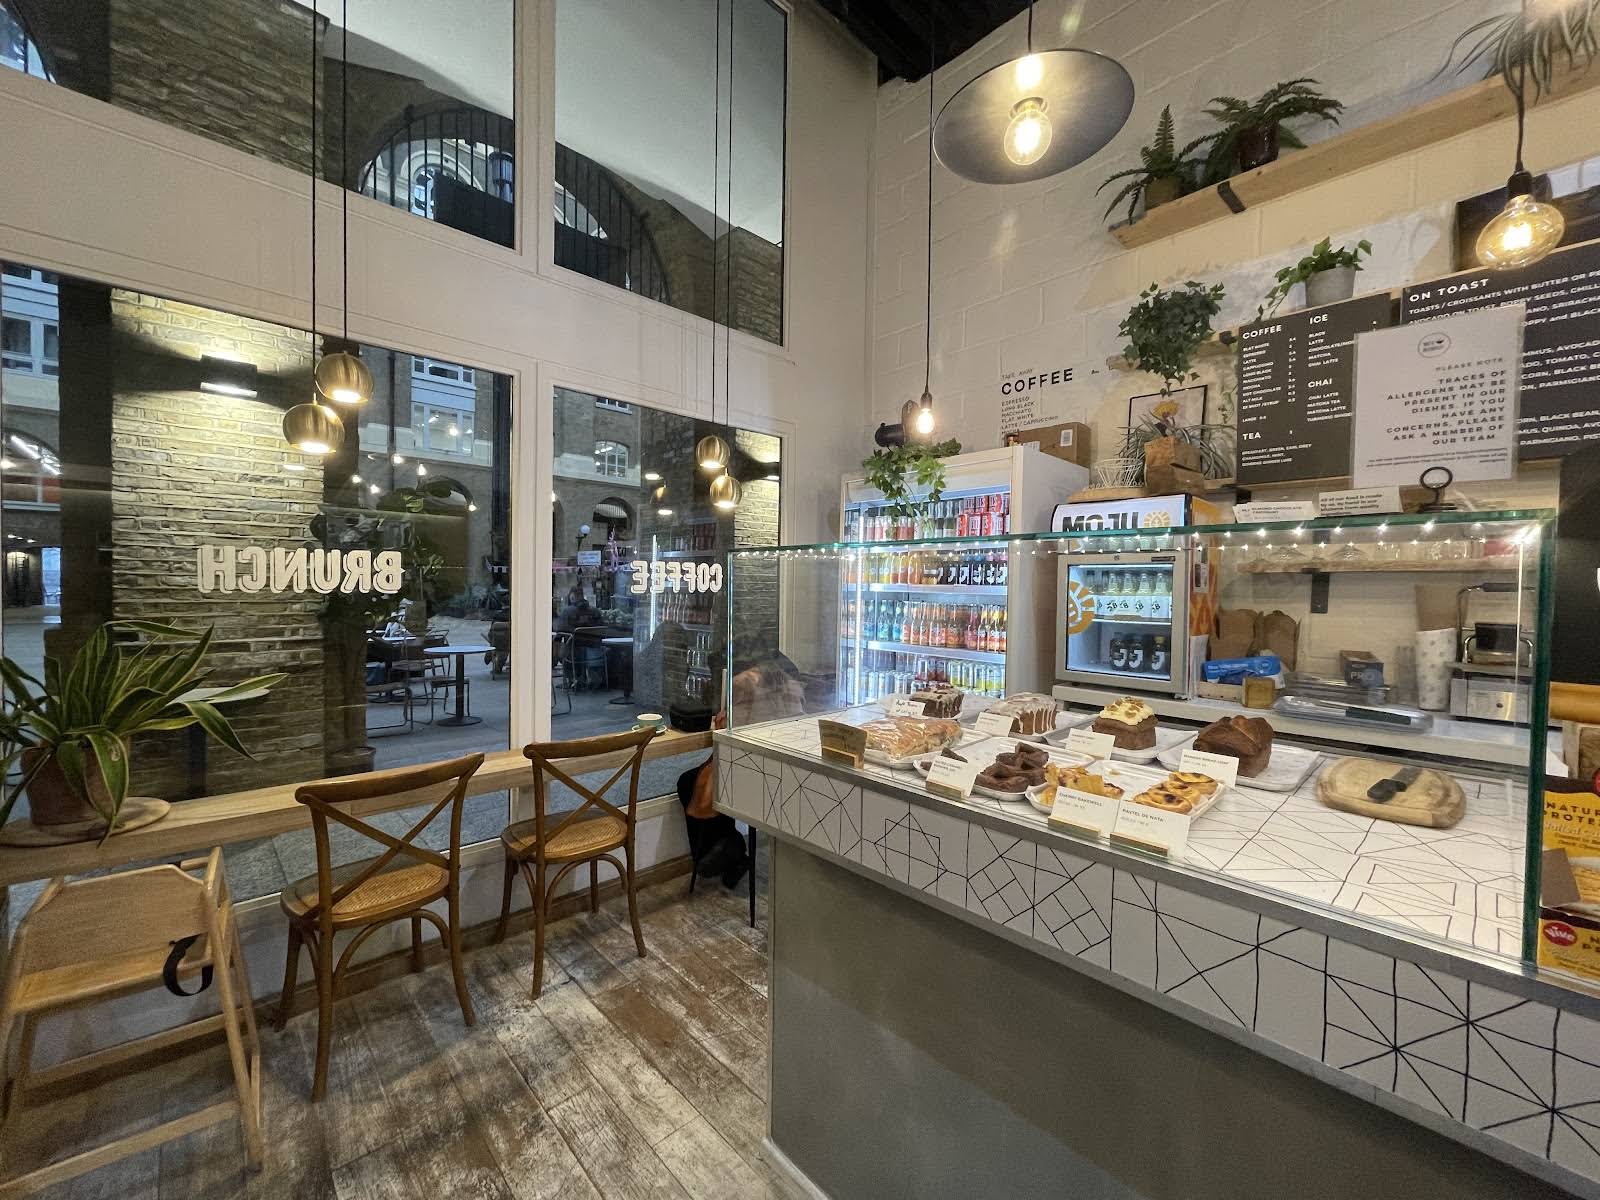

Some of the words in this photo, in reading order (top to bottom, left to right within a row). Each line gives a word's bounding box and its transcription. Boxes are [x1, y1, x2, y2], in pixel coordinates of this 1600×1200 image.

[1409, 291, 1431, 302] ON
[1437, 278, 1489, 296] TOAST
[1409, 303, 1440, 315] TOASTS
[1447, 290, 1502, 307] CROISSANTS
[1503, 285, 1529, 295] WITH
[1531, 277, 1569, 290] BUTTER
[1570, 273, 1586, 281] OR
[1309, 314, 1328, 325] ICE
[1242, 325, 1282, 340] COFFEE
[1308, 338, 1324, 346] LATTE
[1556, 339, 1600, 352] AVOCAD
[1436, 361, 1472, 372] PLEASE
[1553, 365, 1587, 375] BLACK
[1001, 368, 1073, 395] COFFEE
[1308, 378, 1332, 388] CHAI
[1439, 373, 1485, 385] TRACES
[1490, 369, 1507, 377] OF
[1387, 386, 1454, 401] ALLERGENS
[1459, 382, 1485, 391] MAY
[1404, 393, 1457, 407] PRESENT
[1480, 388, 1506, 397] OUR
[1001, 396, 1030, 407] ESPRESSO
[1017, 401, 1035, 409] BLACK
[1480, 397, 1505, 406] YOU
[1017, 413, 1034, 421] WHITE
[1441, 409, 1474, 419] HAVE
[1479, 405, 1505, 415] ANY
[1540, 412, 1570, 422] BLACK
[1457, 415, 1505, 426] PLEASE
[1242, 431, 1261, 440] TEA
[1393, 431, 1415, 441] ASK
[1432, 426, 1483, 437] MEMBER
[1489, 423, 1505, 431] OF
[1432, 436, 1457, 446] OUR
[1463, 433, 1495, 443] TEAM
[1062, 511, 1139, 532] MOJU
[1546, 802, 1600, 816] NATUR
